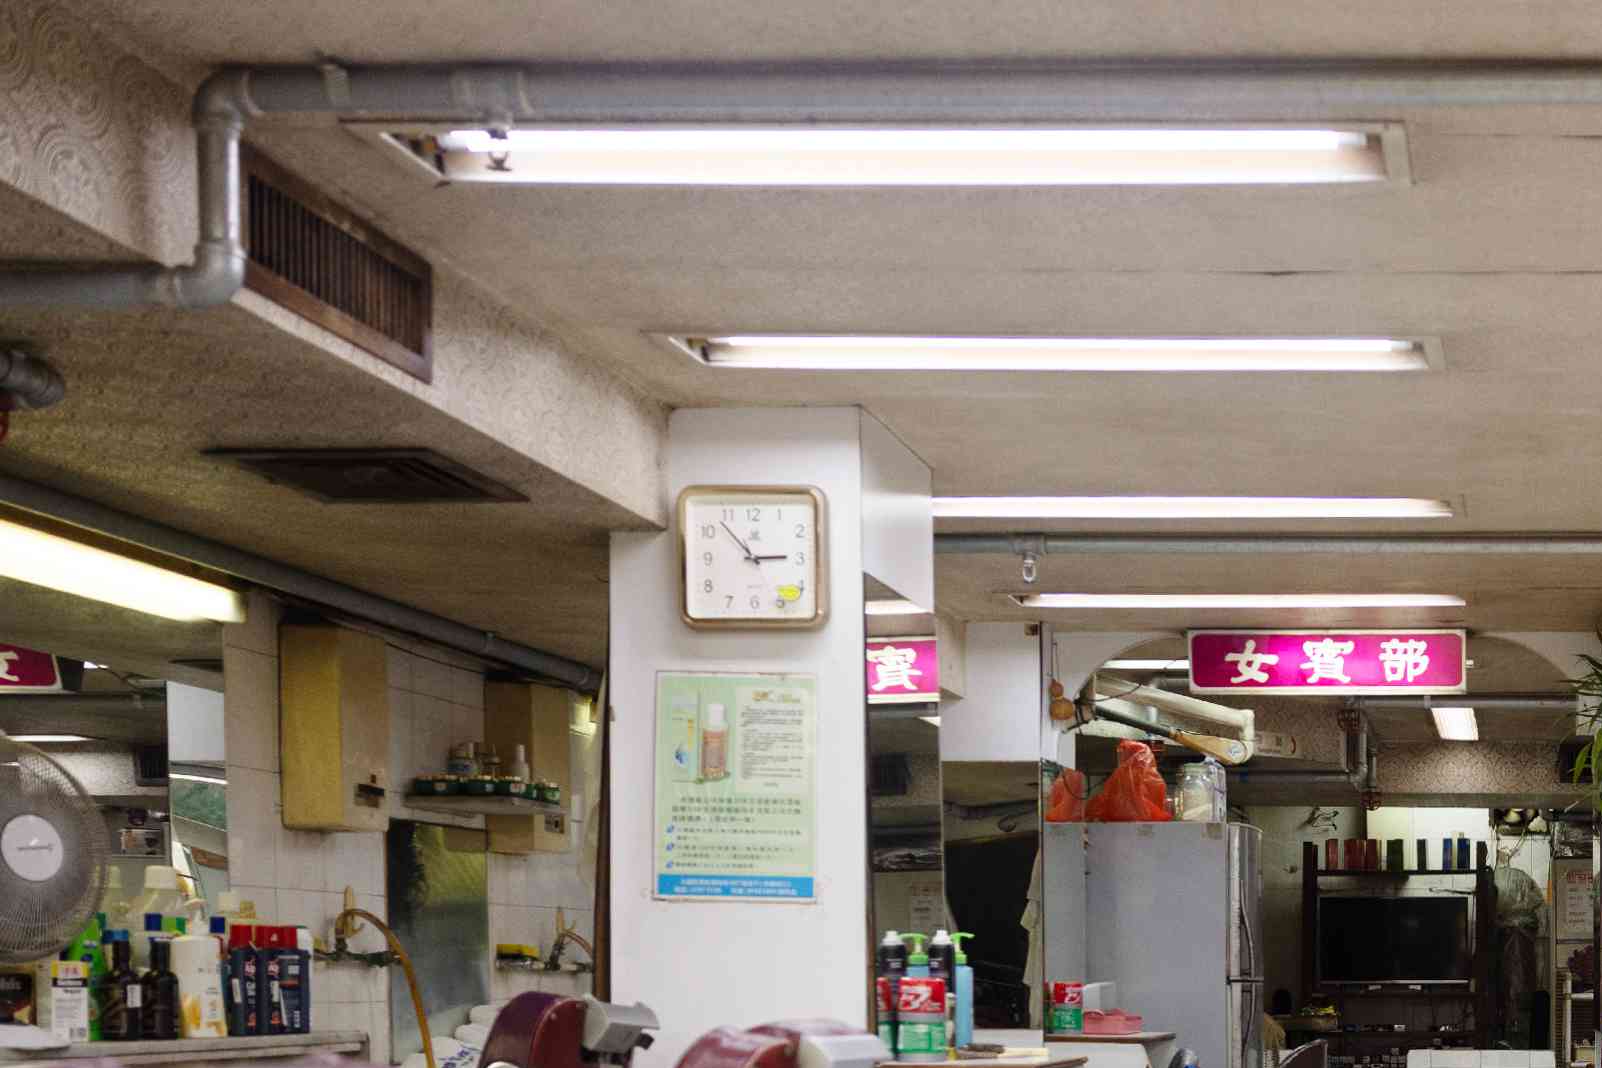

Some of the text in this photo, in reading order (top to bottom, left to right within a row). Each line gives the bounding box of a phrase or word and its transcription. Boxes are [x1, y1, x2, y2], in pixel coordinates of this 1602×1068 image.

[722, 508, 735, 521] 11
[745, 508, 761, 522] 12
[701, 524, 716, 539] 10
[795, 523, 806, 538] 2
[703, 551, 713, 566] 9
[795, 551, 805, 566] 3
[703, 578, 713, 593] 8
[725, 594, 735, 608] 7
[749, 594, 760, 609] 6
